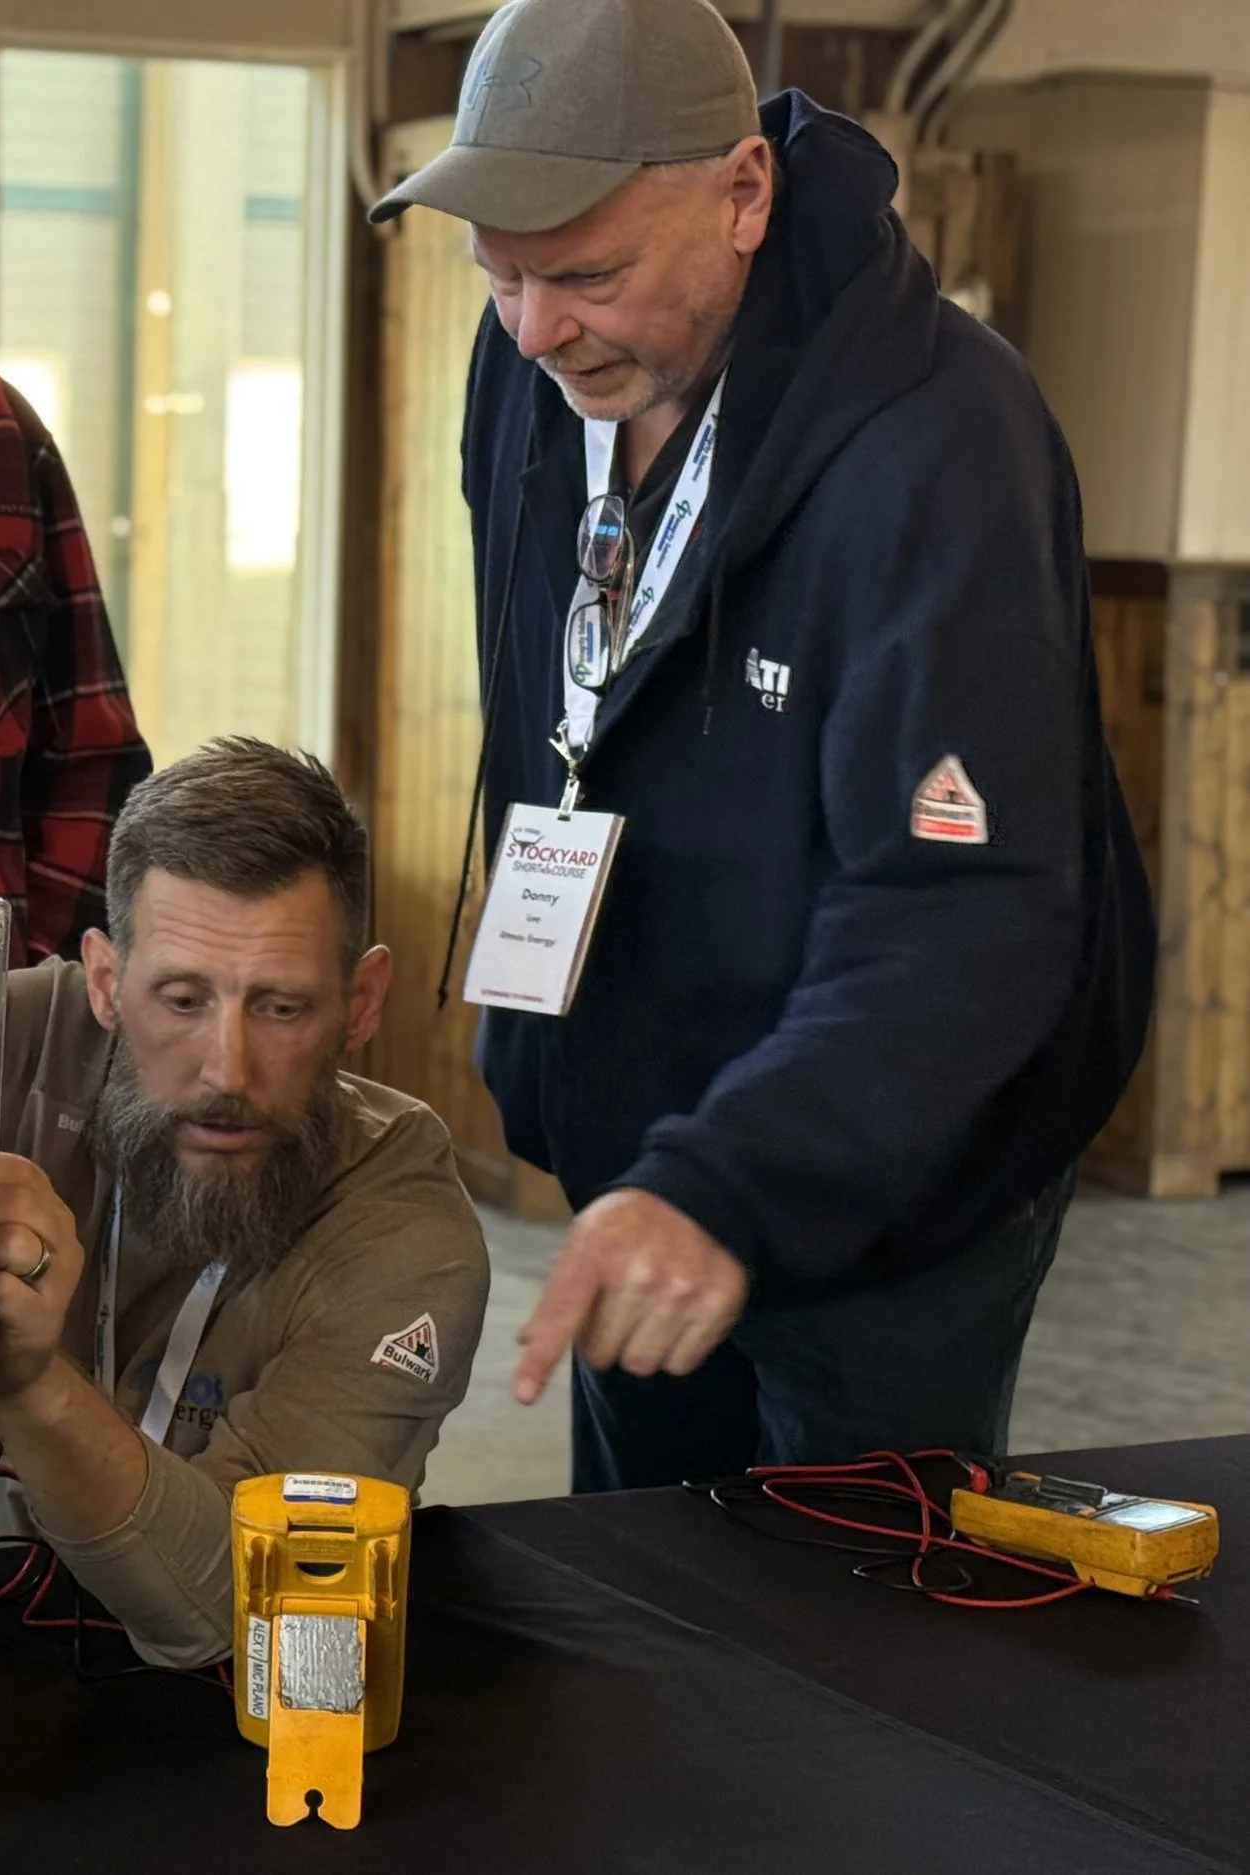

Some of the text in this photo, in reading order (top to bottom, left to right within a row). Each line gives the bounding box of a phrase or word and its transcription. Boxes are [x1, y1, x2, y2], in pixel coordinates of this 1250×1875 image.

[506, 842, 598, 867] STOCKYARD
[512, 860, 587, 879] SHORT COURSE
[522, 888, 560, 907] Danny
[382, 1344, 432, 1384] Bulwark
[252, 1620, 266, 1646] ALEX
[251, 1662, 265, 1716] MIC PLANO
